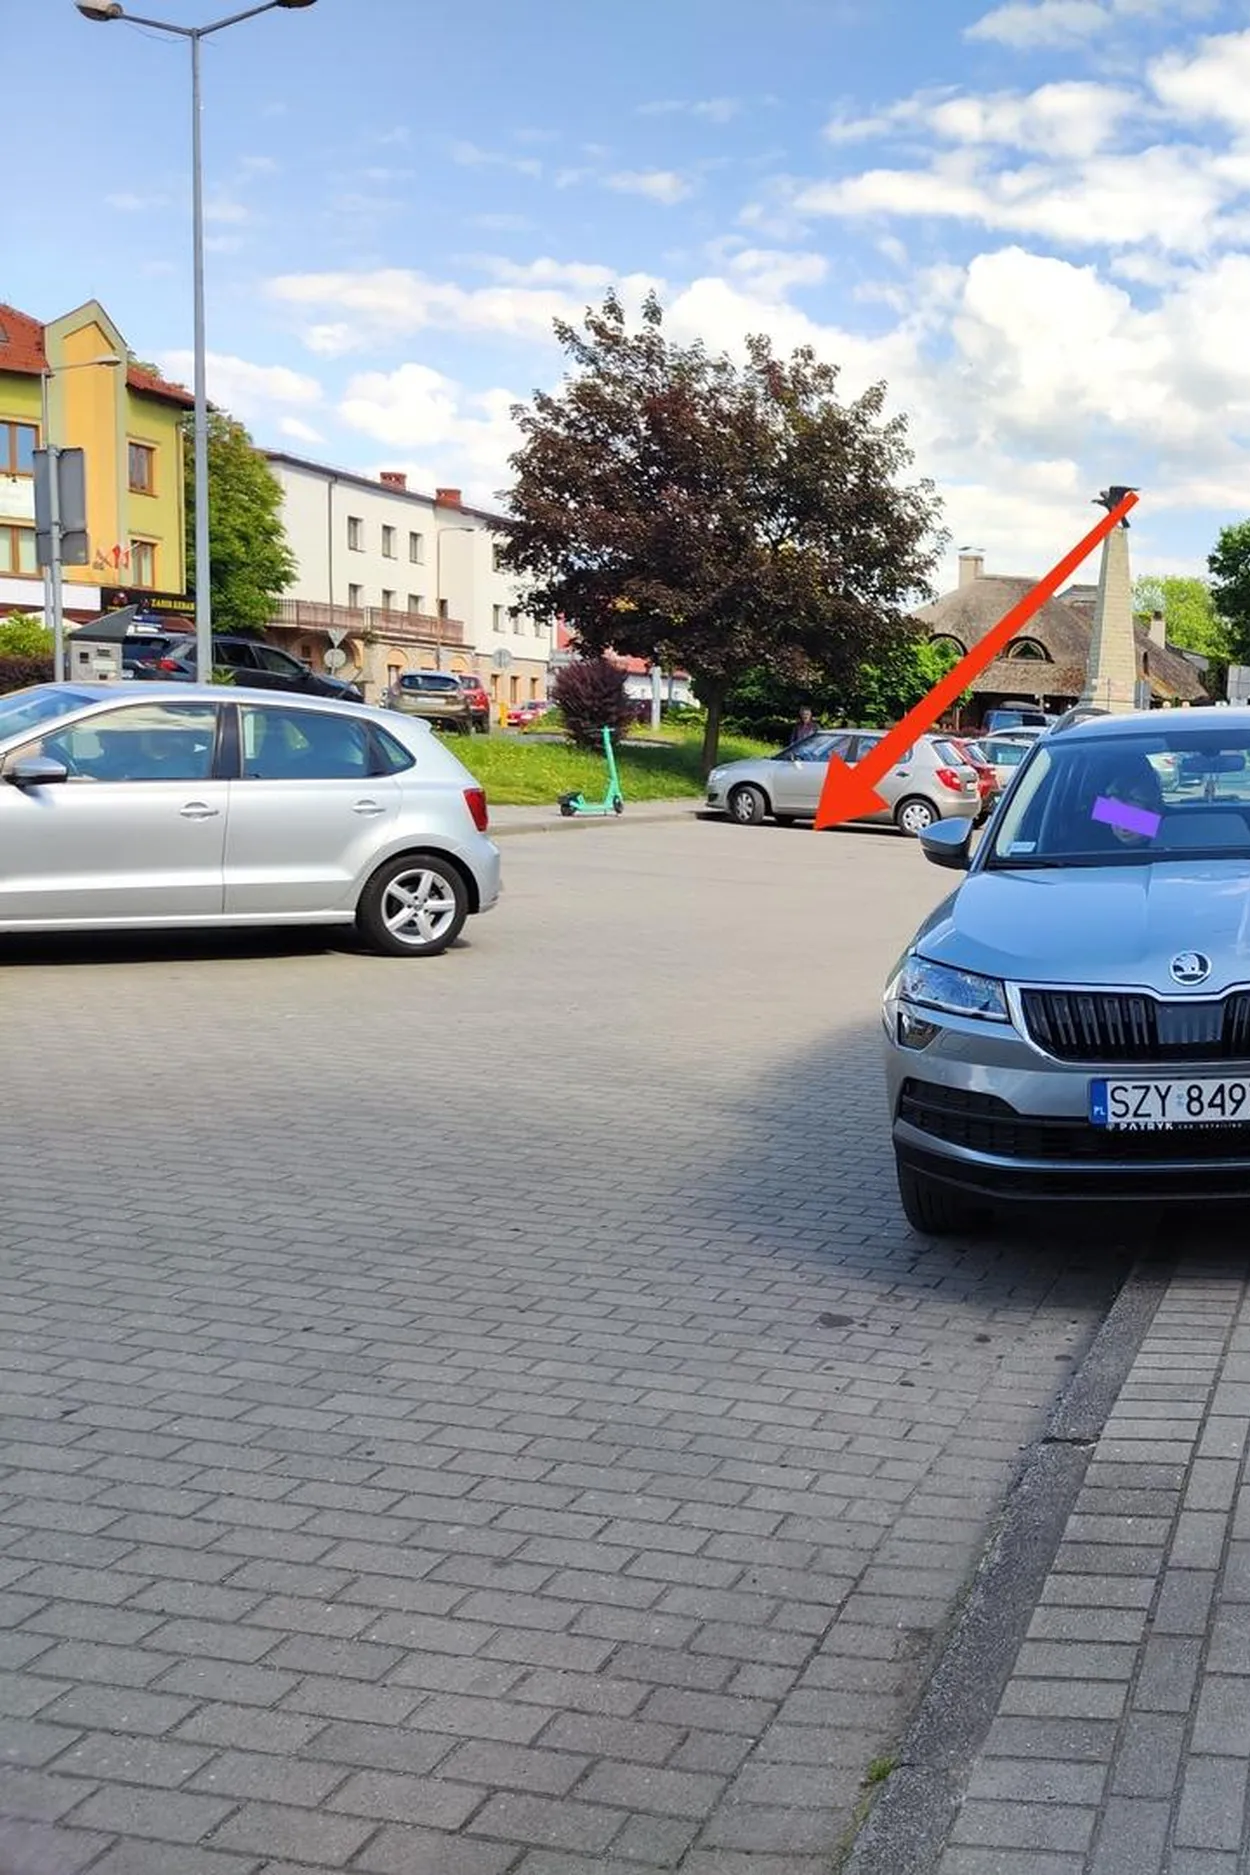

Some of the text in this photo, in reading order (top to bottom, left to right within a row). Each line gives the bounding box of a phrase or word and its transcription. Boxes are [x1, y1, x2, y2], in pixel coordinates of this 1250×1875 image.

[1110, 1085, 1172, 1119] SZY
[1093, 1106, 1106, 1116] PL
[1119, 1121, 1174, 1131] PATRYK
